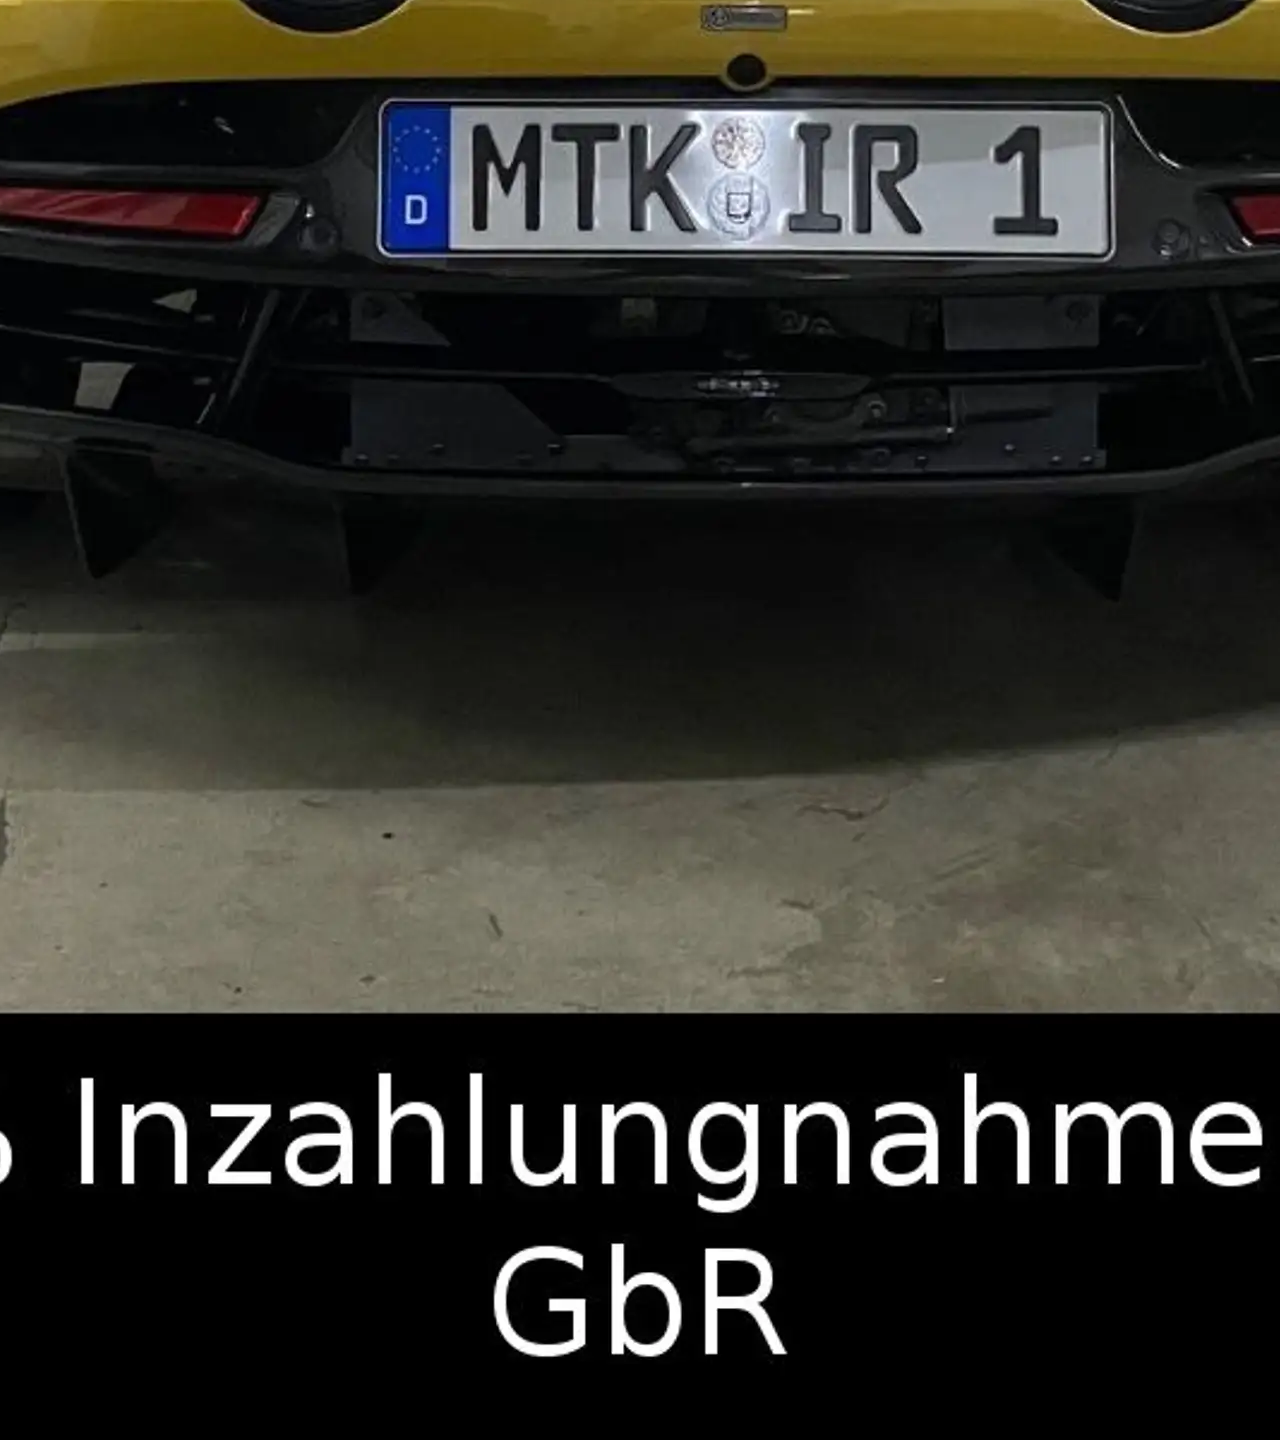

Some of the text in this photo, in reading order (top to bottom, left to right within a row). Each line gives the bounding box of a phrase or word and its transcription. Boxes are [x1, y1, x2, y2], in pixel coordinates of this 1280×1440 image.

[405, 194, 428, 226] D
[471, 122, 1060, 237] MTK IR 1
